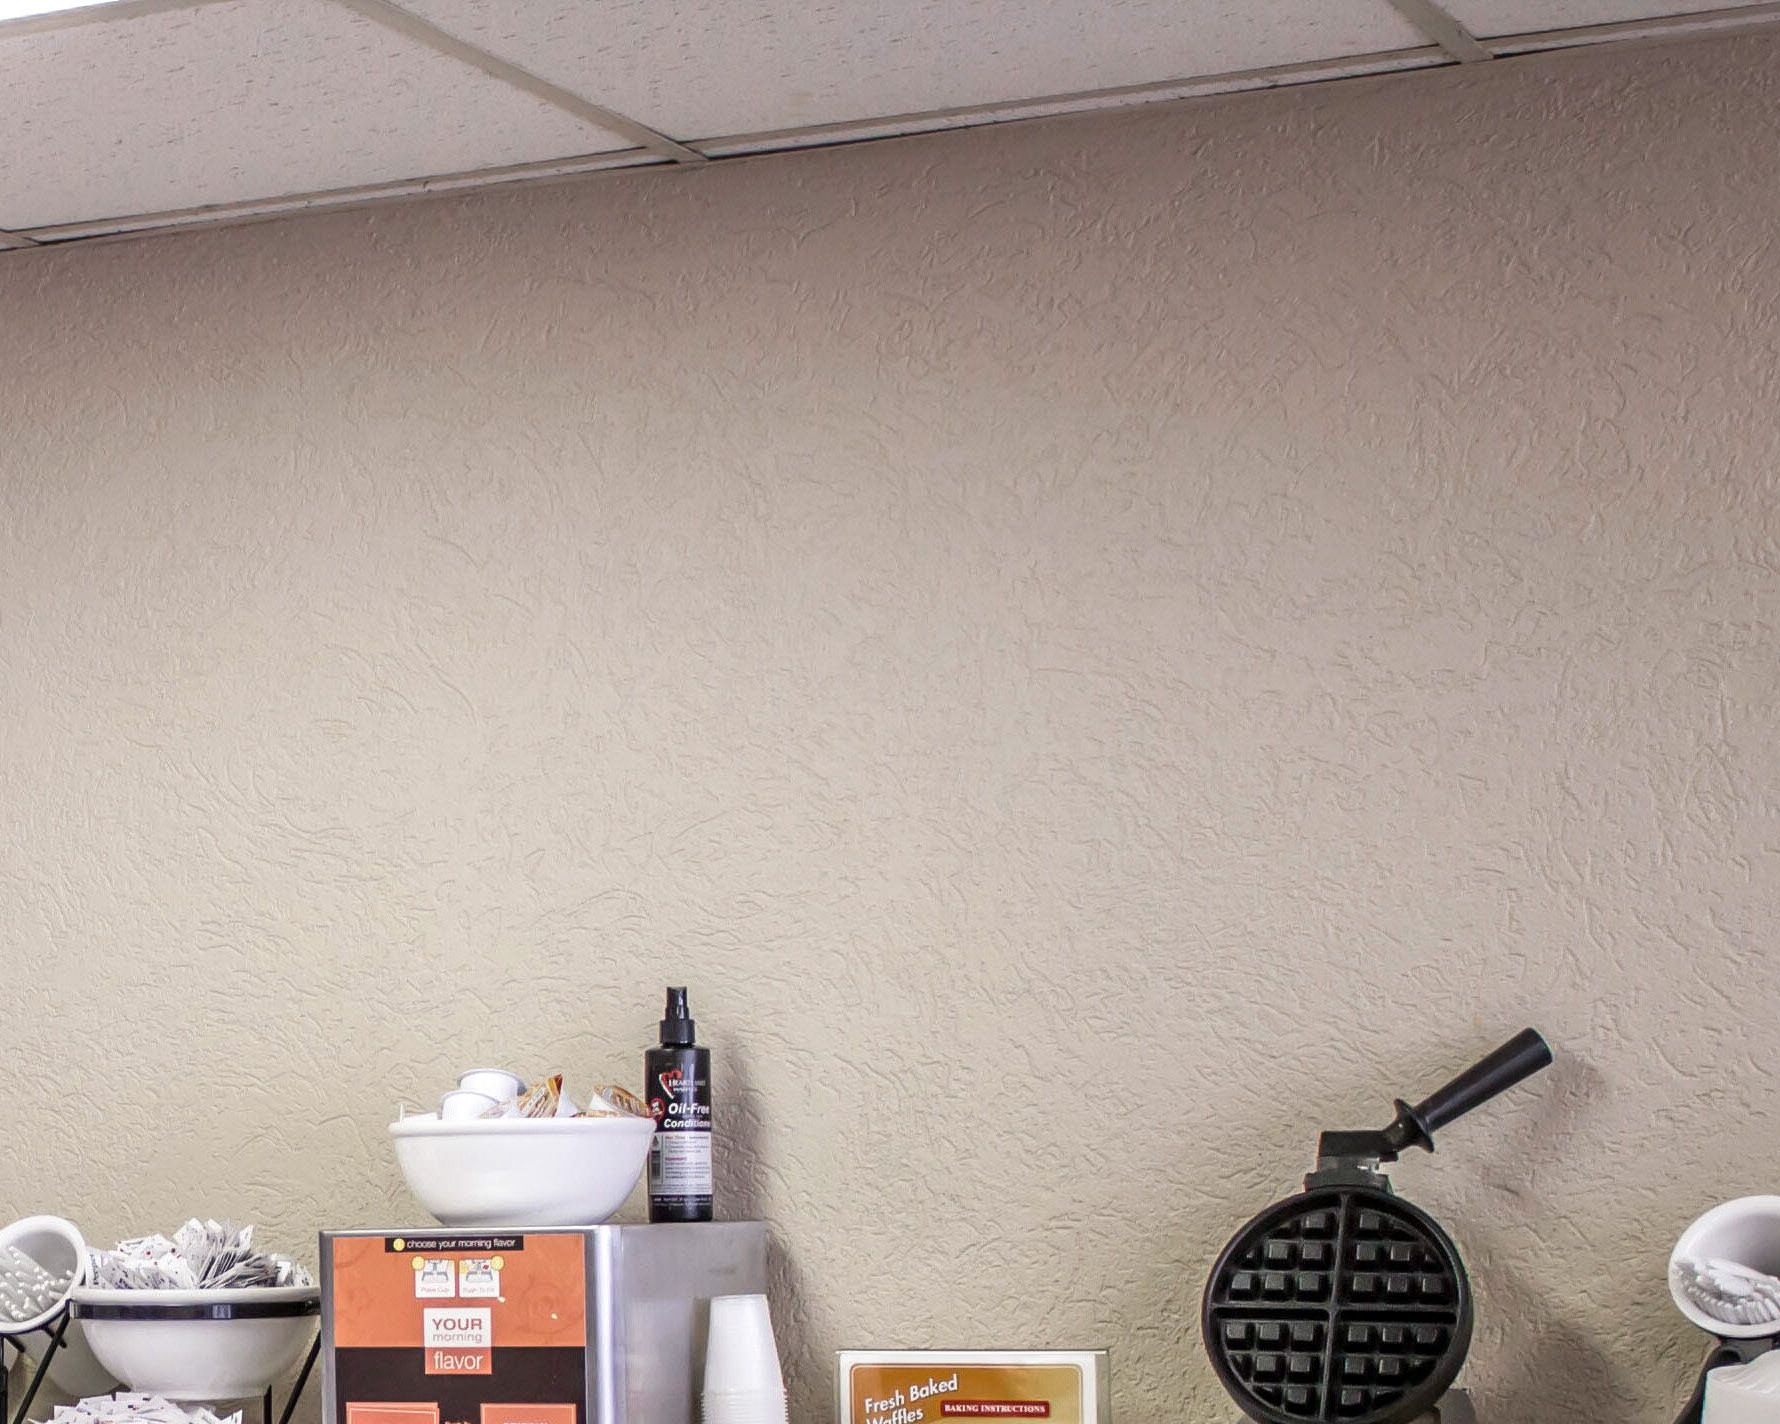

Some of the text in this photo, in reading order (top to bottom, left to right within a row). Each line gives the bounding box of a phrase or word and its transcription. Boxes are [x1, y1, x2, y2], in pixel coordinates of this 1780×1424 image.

[406, 1238, 516, 1250] choose your morning flavor
[431, 1318, 482, 1330] YOUR
[432, 1332, 482, 1344] morning
[433, 1351, 484, 1370] flavor
[864, 1373, 959, 1414] Fresh Baked
[944, 1404, 1046, 1413] BAKING INSTRUCTIONS
